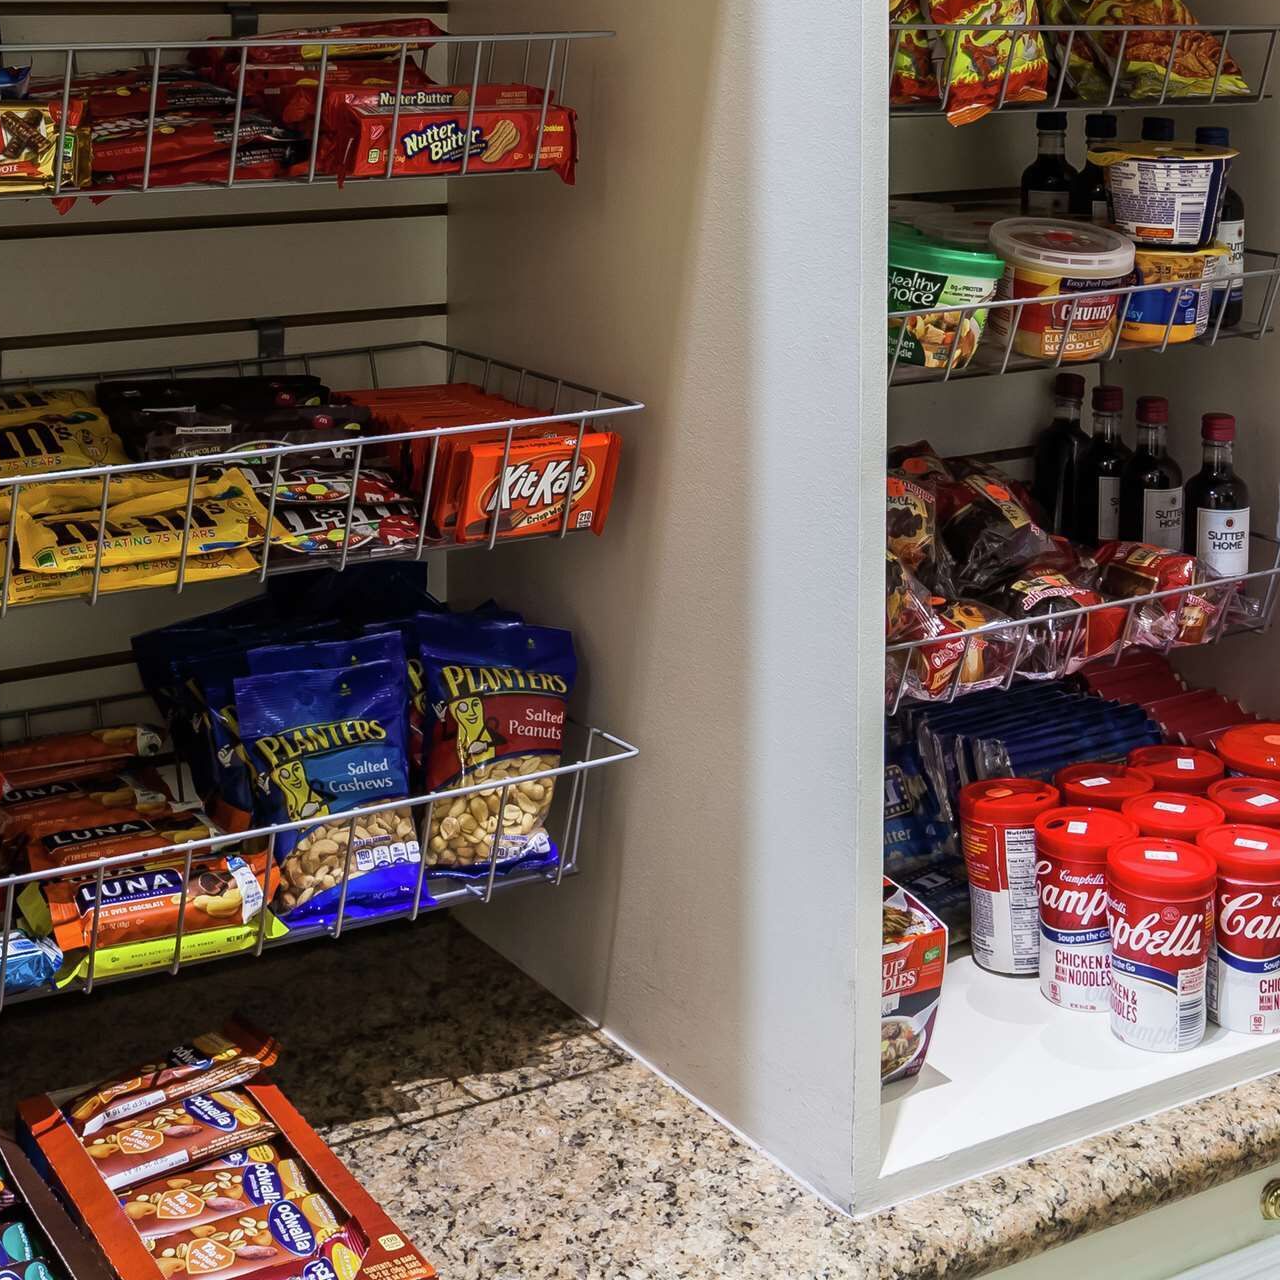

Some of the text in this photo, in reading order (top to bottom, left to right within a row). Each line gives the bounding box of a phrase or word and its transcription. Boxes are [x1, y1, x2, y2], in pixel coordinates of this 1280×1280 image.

[418, 92, 452, 104] Butter
[404, 123, 456, 157] Nutter
[1177, 271, 1200, 280] water
[1060, 303, 1115, 322] CHUNKY
[7, 461, 19, 471] 75
[22, 455, 62, 469] YEARS
[527, 513, 549, 524] Crisp
[580, 513, 592, 521] 210
[61, 533, 170, 556] CELEBRATING 75
[1207, 531, 1246, 541] SUTTER
[1213, 540, 1244, 550] HOME
[442, 665, 568, 697] PLANTERS
[525, 708, 564, 725] Salted
[509, 719, 562, 741] Peanuts
[255, 719, 387, 765] PLANTERS
[347, 758, 389, 776] Salted
[328, 776, 394, 794] Cashews
[53, 822, 140, 844] LUNA
[1059, 869, 1105, 886] Campbell's
[81, 872, 174, 902] LUNA
[1058, 932, 1075, 943] Soup
[1076, 934, 1086, 942] on
[1086, 933, 1099, 941] the
[1055, 950, 1111, 969] CHICKEN &
[1264, 957, 1278, 971] Soup
[1126, 964, 1136, 973] Go
[1068, 970, 1112, 987] NOODLES
[1131, 991, 1138, 1007] &
[1253, 1016, 1262, 1024] 60
[190, 1096, 232, 1126] odwalla
[277, 1204, 311, 1253] odwalla
[381, 1236, 398, 1246] 200
